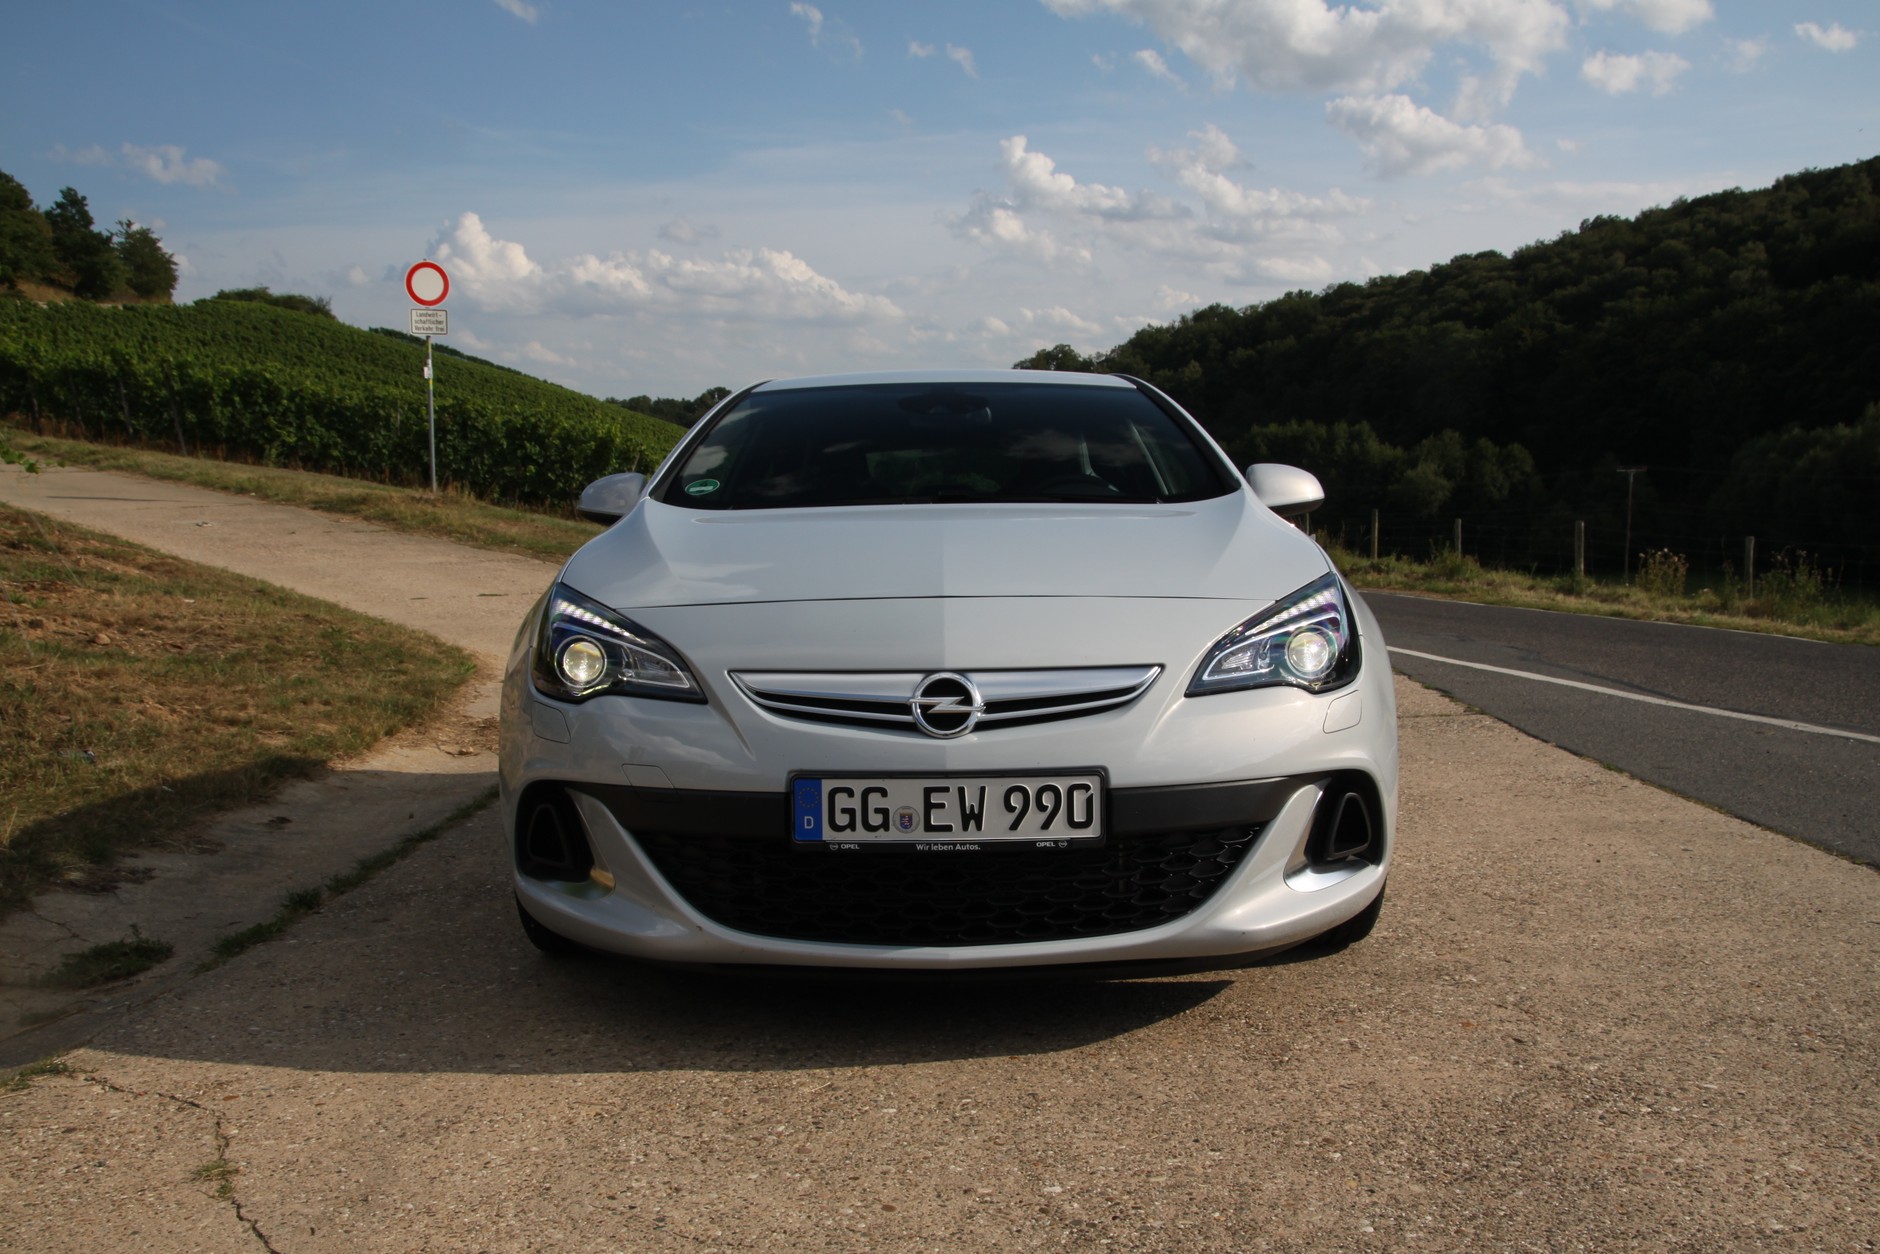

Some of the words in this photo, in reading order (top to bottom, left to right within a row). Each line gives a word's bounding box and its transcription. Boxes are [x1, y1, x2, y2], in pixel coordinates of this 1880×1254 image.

[828, 786, 890, 832] GG
[923, 785, 987, 832] EW
[1003, 783, 1094, 831] 990
[804, 816, 814, 829] D
[916, 843, 930, 851] Wir
[931, 843, 953, 851] leben
[955, 843, 981, 851] Autos.
